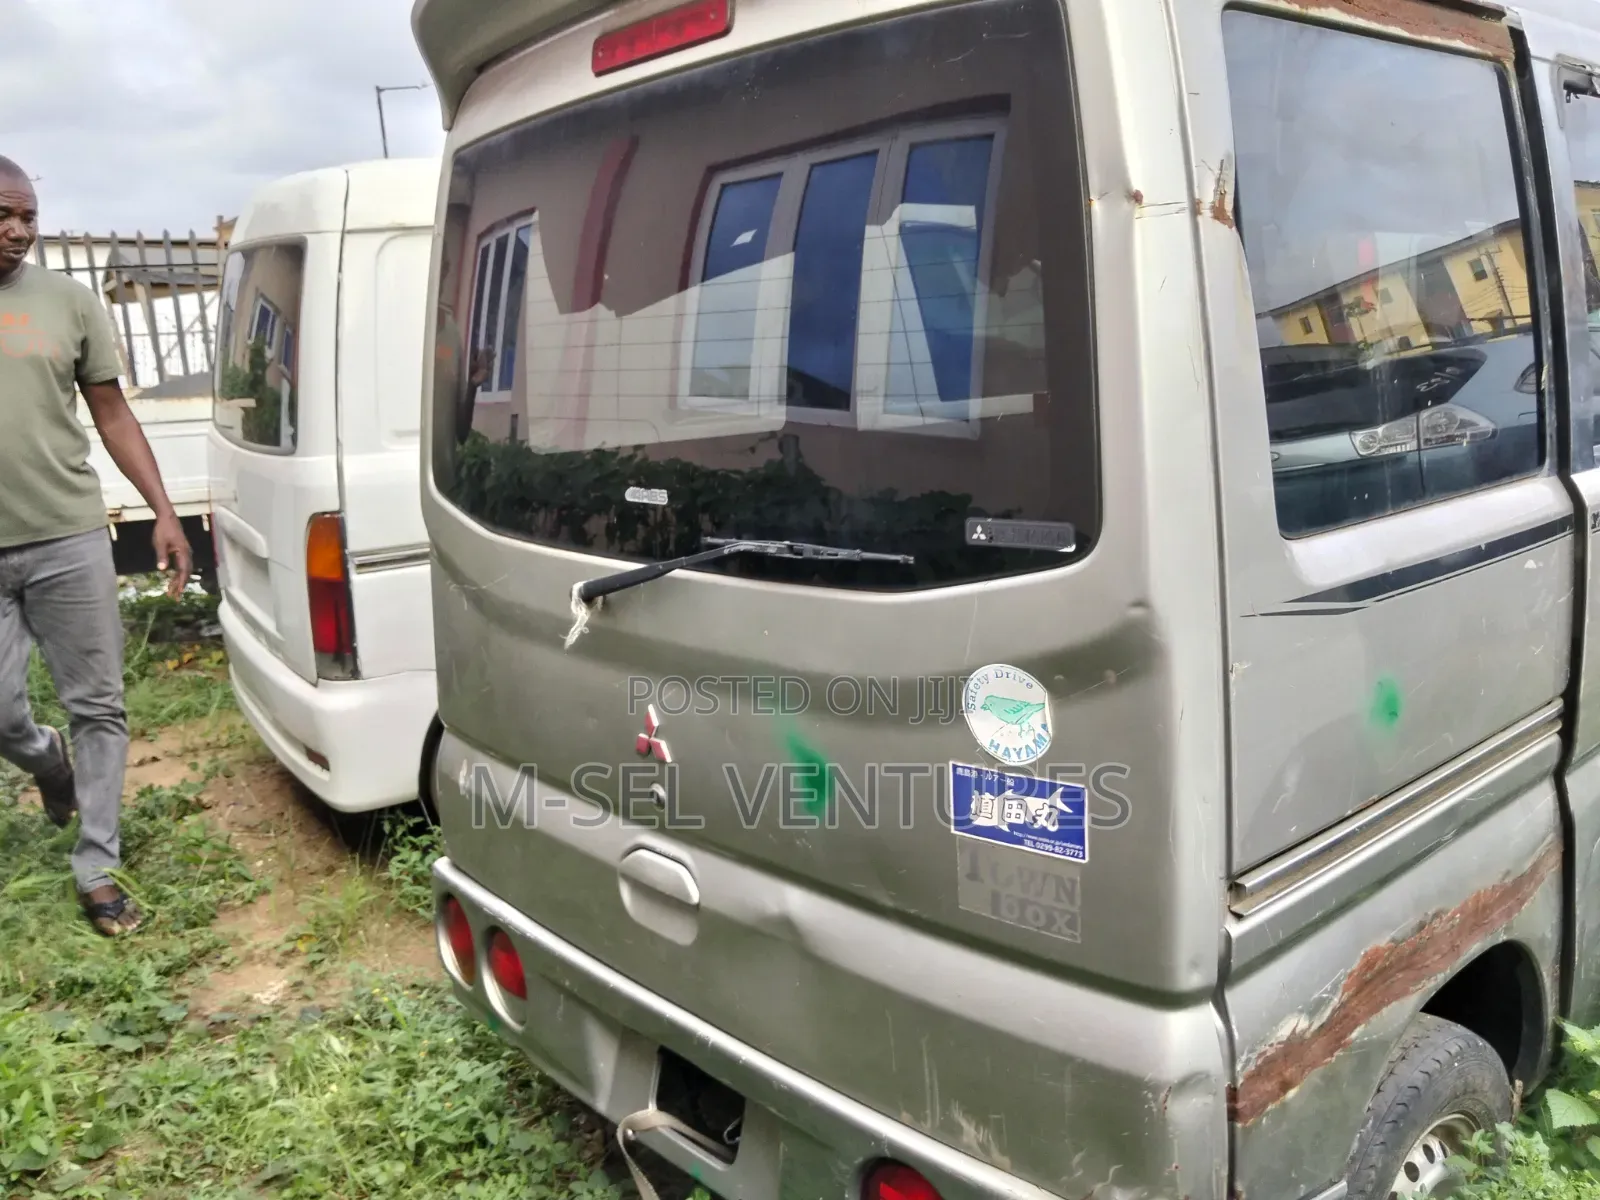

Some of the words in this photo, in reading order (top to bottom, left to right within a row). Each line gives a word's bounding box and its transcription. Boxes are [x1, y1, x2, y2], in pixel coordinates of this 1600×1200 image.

[966, 673, 990, 711] Safety
[994, 668, 1034, 690] Drive
[1023, 838, 1035, 848] TEL
